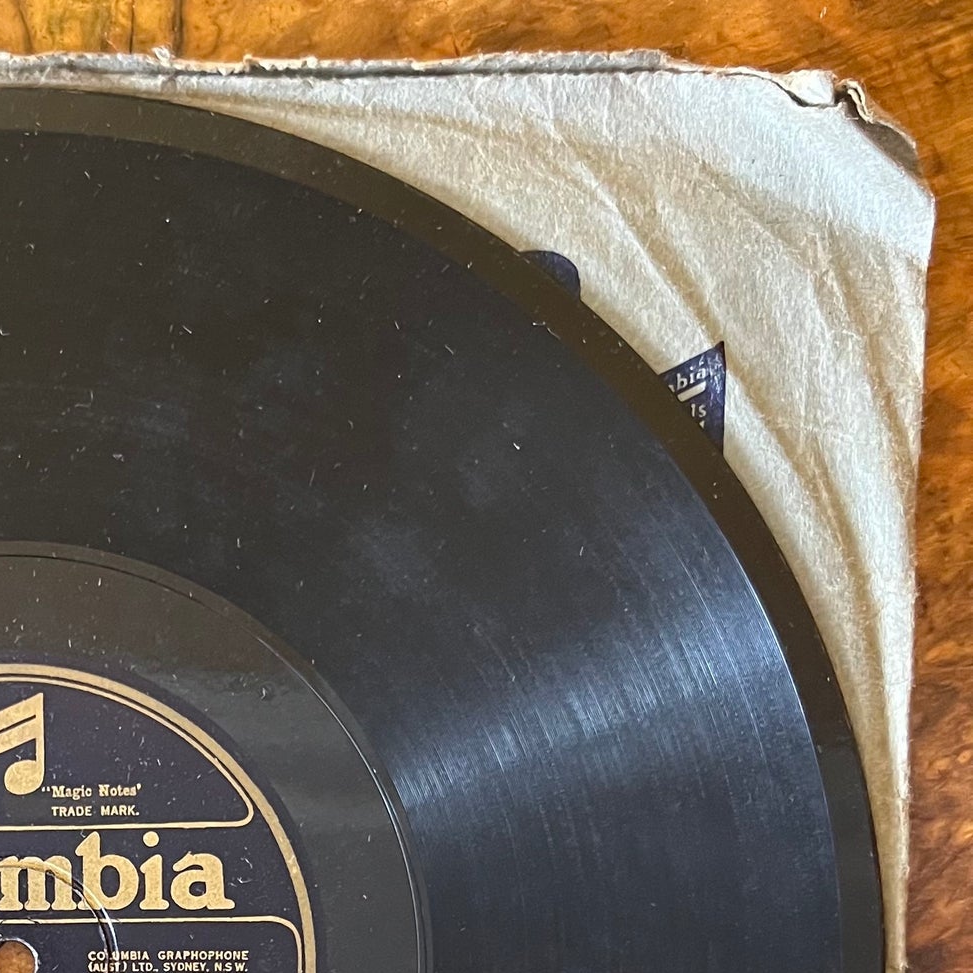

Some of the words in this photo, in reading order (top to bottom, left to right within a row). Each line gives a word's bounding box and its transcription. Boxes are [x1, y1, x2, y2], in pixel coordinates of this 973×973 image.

[51, 806, 93, 817] TRADE
[100, 805, 140, 816] MARK.
[157, 950, 249, 961] GRAPHOPHONE
